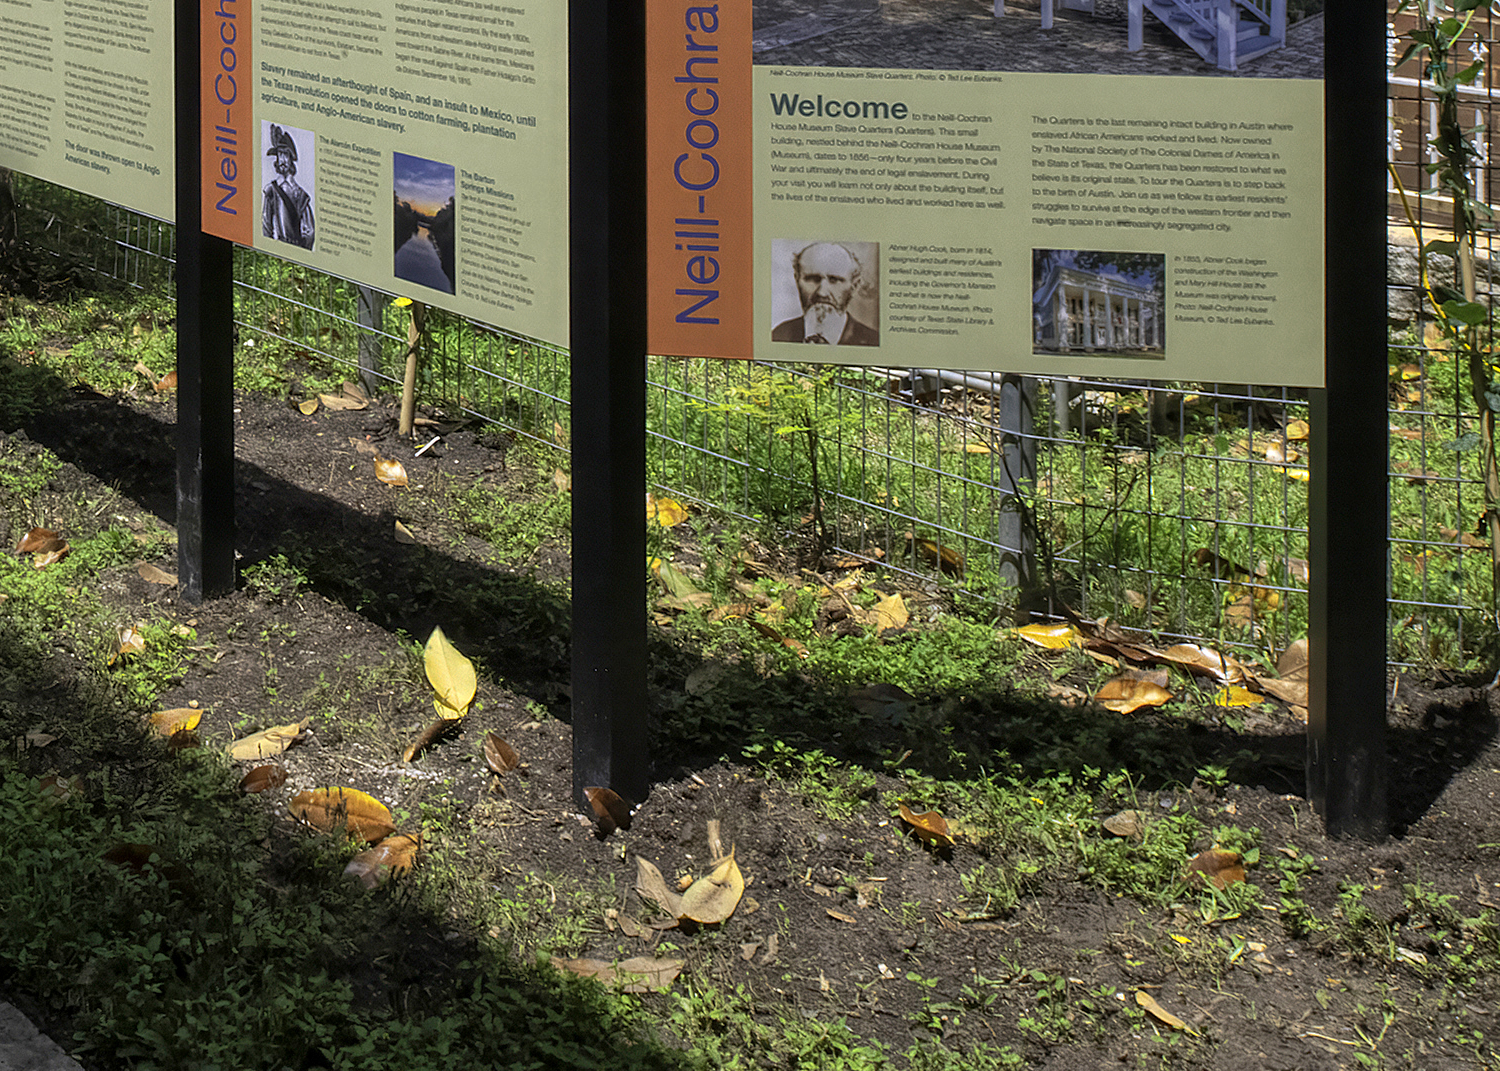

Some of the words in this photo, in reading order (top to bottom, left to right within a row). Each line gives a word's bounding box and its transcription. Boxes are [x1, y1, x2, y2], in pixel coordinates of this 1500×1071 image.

[261, 61, 286, 80] Slavery
[286, 68, 320, 82] remained
[320, 75, 331, 84] an
[331, 77, 378, 95] afterthought
[379, 86, 388, 96] of
[388, 87, 414, 103] Spain,
[414, 95, 431, 106] and
[432, 98, 443, 108] an
[444, 98, 468, 113] insult
[468, 104, 479, 115] to
[480, 106, 514, 124] Mexico,
[516, 115, 536, 127] until
[261, 77, 272, 87] the
[273, 79, 293, 92] Texas
[294, 85, 330, 99] revolution
[330, 93, 359, 106] opened
[360, 98, 373, 109] the
[373, 101, 397, 114] doors
[398, 106, 407, 116] to
[408, 110, 435, 122] cotton
[435, 114, 471, 132] farming,
[472, 122, 516, 140] plantation
[769, 93, 908, 119] Welcome
[911, 112, 921, 121] to
[922, 113, 936, 121] the
[936, 113, 992, 123] Neill-Cochran
[261, 93, 300, 109] agriculture,
[300, 102, 315, 112] and
[315, 104, 375, 125] Anglo-American
[376, 118, 406, 134] slavery.
[64, 138, 75, 150] The
[75, 143, 89, 153] door
[88, 148, 100, 158] was
[100, 150, 120, 163] thrown
[121, 158, 135, 167] open
[136, 161, 142, 170] to
[64, 152, 90, 167] American
[90, 161, 110, 175] slavery.
